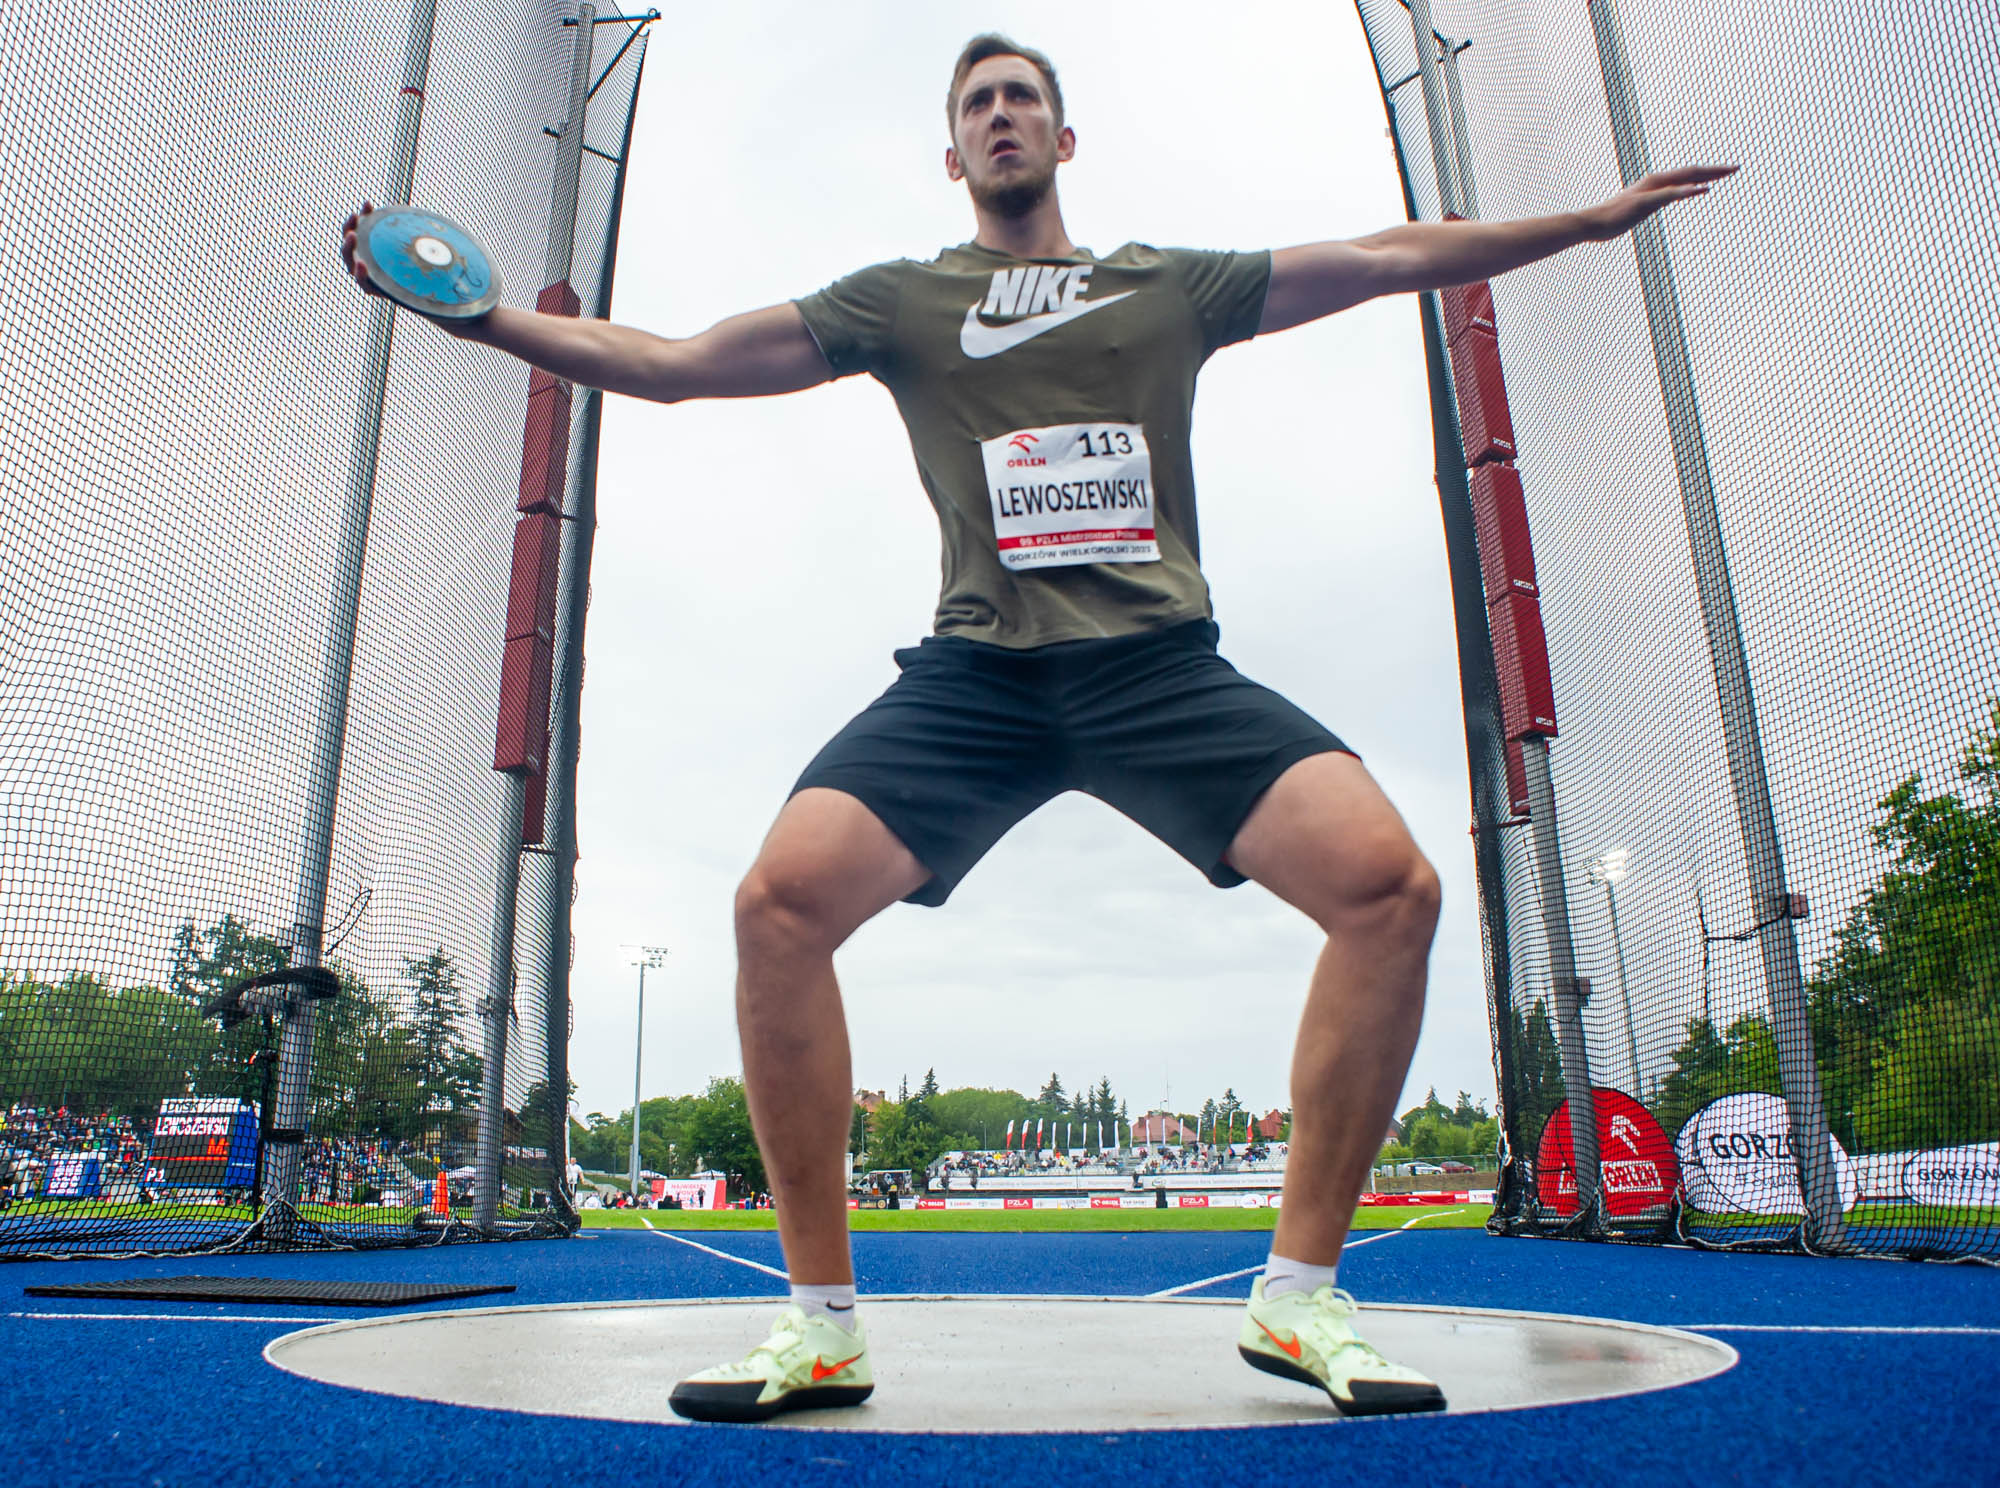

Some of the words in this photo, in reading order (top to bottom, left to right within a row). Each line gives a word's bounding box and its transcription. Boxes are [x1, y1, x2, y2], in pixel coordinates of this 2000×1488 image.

[981, 265, 1094, 316] NIKE
[1079, 431, 1133, 458] 113
[1007, 457, 1047, 468] ORLEN
[998, 479, 1148, 518] LEWOSZEWSKI
[1036, 534, 1060, 545] PZLA
[1008, 550, 1057, 563] GORZÓW
[1060, 545, 1129, 558] WIELKOPOLSKI
[1007, 1199, 1029, 1207] PZLA
[1182, 1197, 1205, 1205] PZLA
